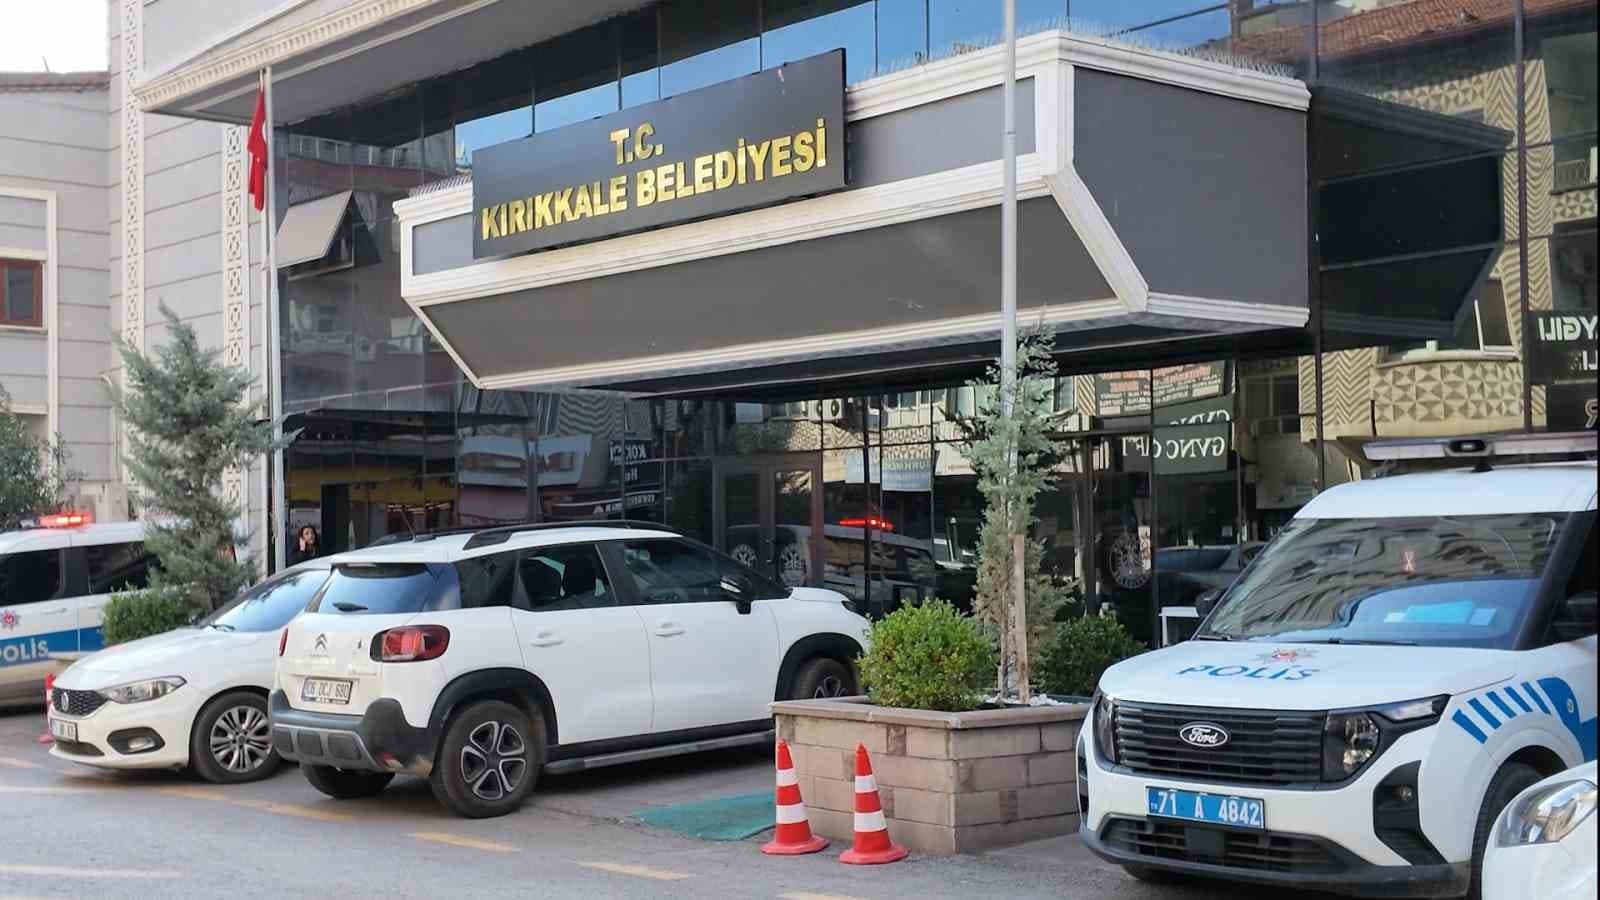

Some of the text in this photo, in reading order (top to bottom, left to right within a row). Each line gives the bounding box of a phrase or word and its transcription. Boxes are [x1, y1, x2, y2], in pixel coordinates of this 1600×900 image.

[610, 122, 663, 165] T.C.
[481, 118, 827, 240] KIRIKKALE BELEDİYESİ
[0, 638, 48, 663] OLİS
[1188, 727, 1218, 744] Ford
[1158, 791, 1260, 826] 71 A 4842
